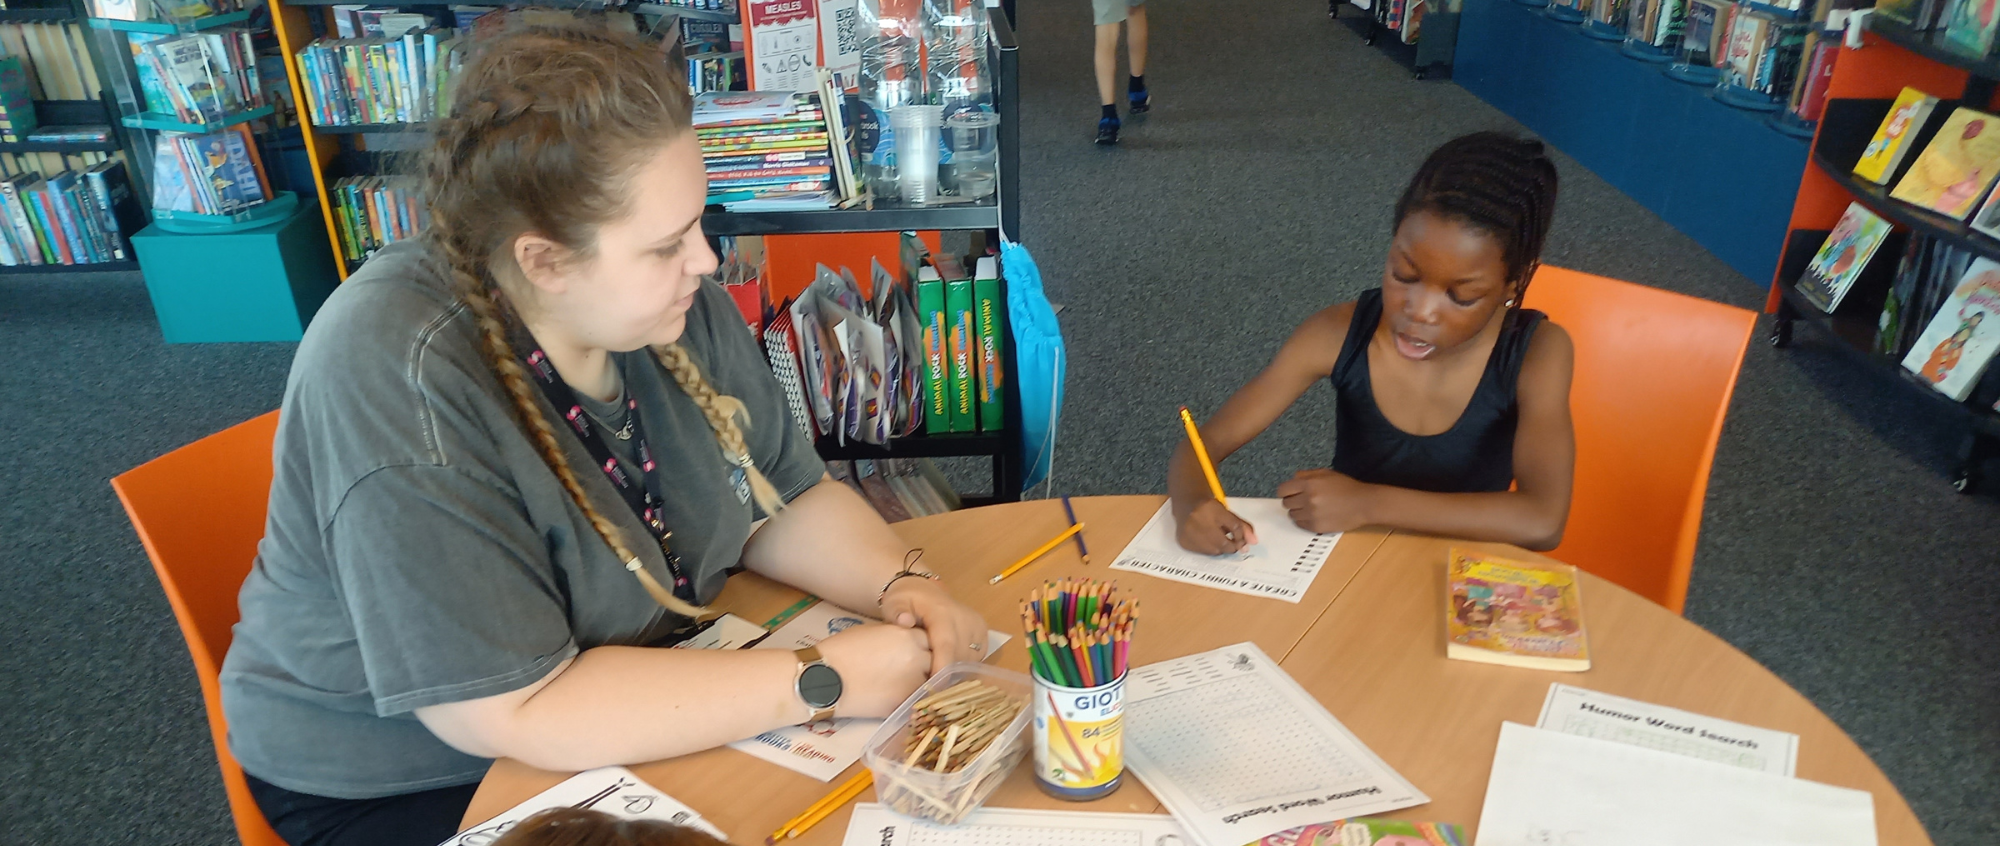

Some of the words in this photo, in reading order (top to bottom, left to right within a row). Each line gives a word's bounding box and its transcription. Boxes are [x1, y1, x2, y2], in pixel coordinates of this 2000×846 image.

[765, 1, 802, 15] MEASLES
[981, 298, 992, 335] ANIMAL
[983, 335, 994, 363] ROCK
[931, 352, 942, 379] ROCK
[957, 351, 968, 379] ROCK
[933, 380, 943, 415] ANIMAL
[959, 379, 969, 415] ANIMAL
[1131, 560, 1197, 578] CHARACTER
[1198, 574, 1237, 587] FUNNY
[1250, 583, 1297, 597] CREATE
[1082, 727, 1100, 739] 84
[1579, 702, 1641, 723] Humor
[1645, 716, 1696, 735] Word
[1699, 729, 1759, 750] Search
[1325, 785, 1383, 802] Humor
[1278, 797, 1325, 812] Word
[1222, 805, 1279, 825] Search
